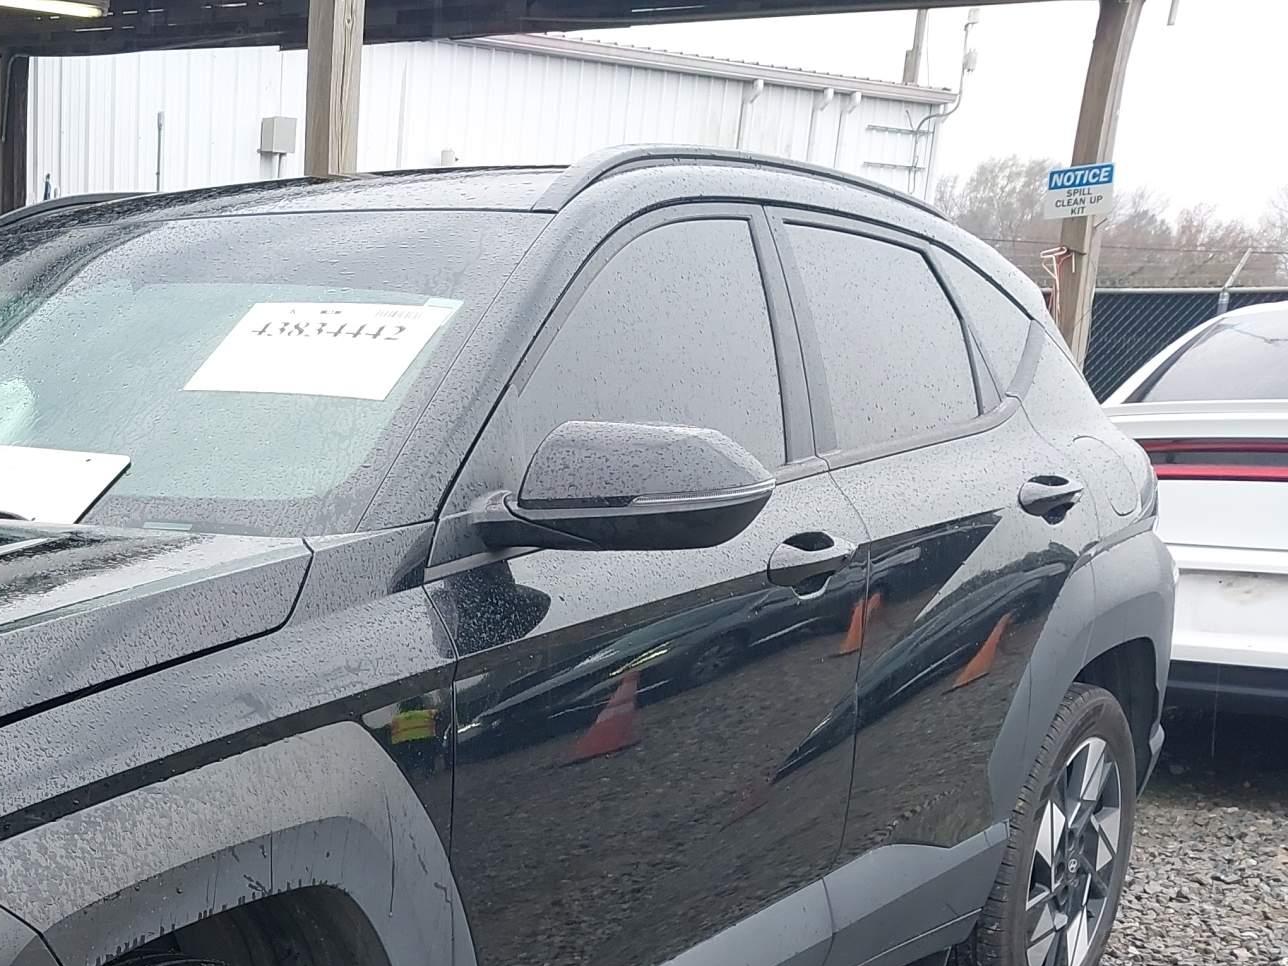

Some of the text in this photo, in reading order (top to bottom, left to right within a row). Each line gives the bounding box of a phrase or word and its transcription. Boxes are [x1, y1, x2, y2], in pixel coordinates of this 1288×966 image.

[1051, 167, 1111, 188] NOTICE
[1066, 188, 1093, 198] SPILL
[1055, 195, 1103, 208] CLEAN UP
[1070, 207, 1086, 216] KIT
[251, 320, 407, 341] 43834442
